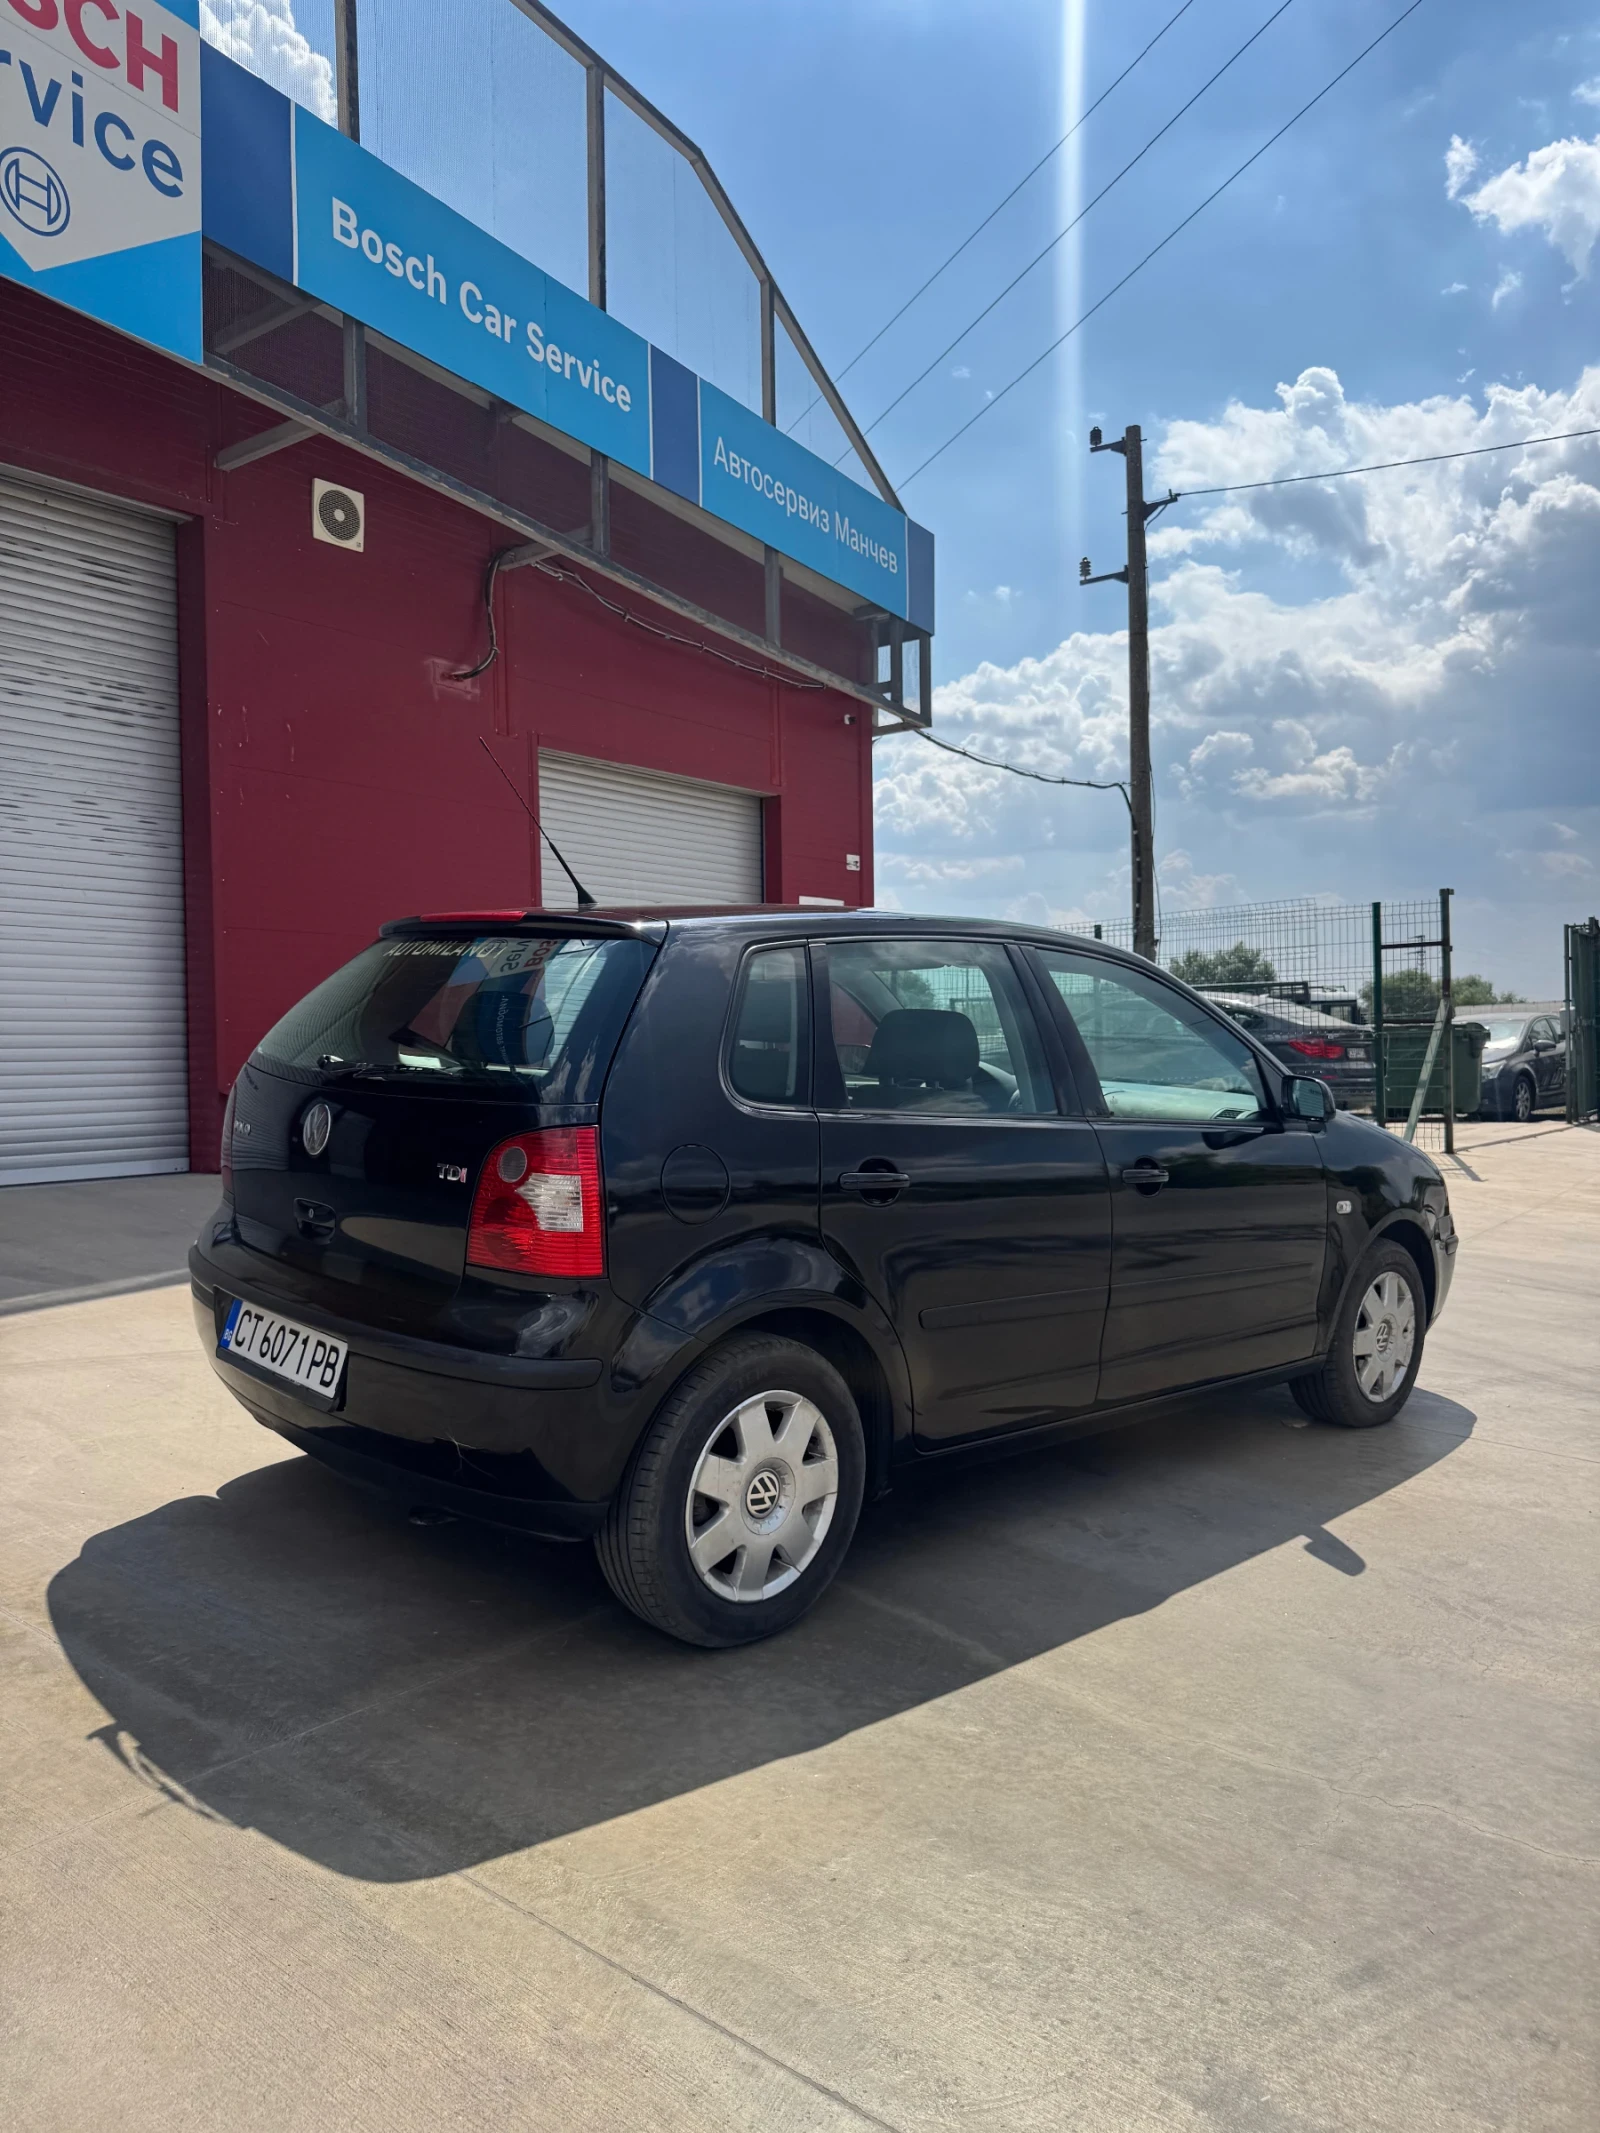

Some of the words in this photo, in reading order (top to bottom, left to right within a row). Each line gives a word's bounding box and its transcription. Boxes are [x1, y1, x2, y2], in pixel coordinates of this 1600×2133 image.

[332, 196, 447, 305] Bosch
[459, 281, 517, 343] Car
[526, 321, 632, 412] Service
[714, 436, 830, 533] Автосервиз
[834, 511, 898, 574] Манчев
